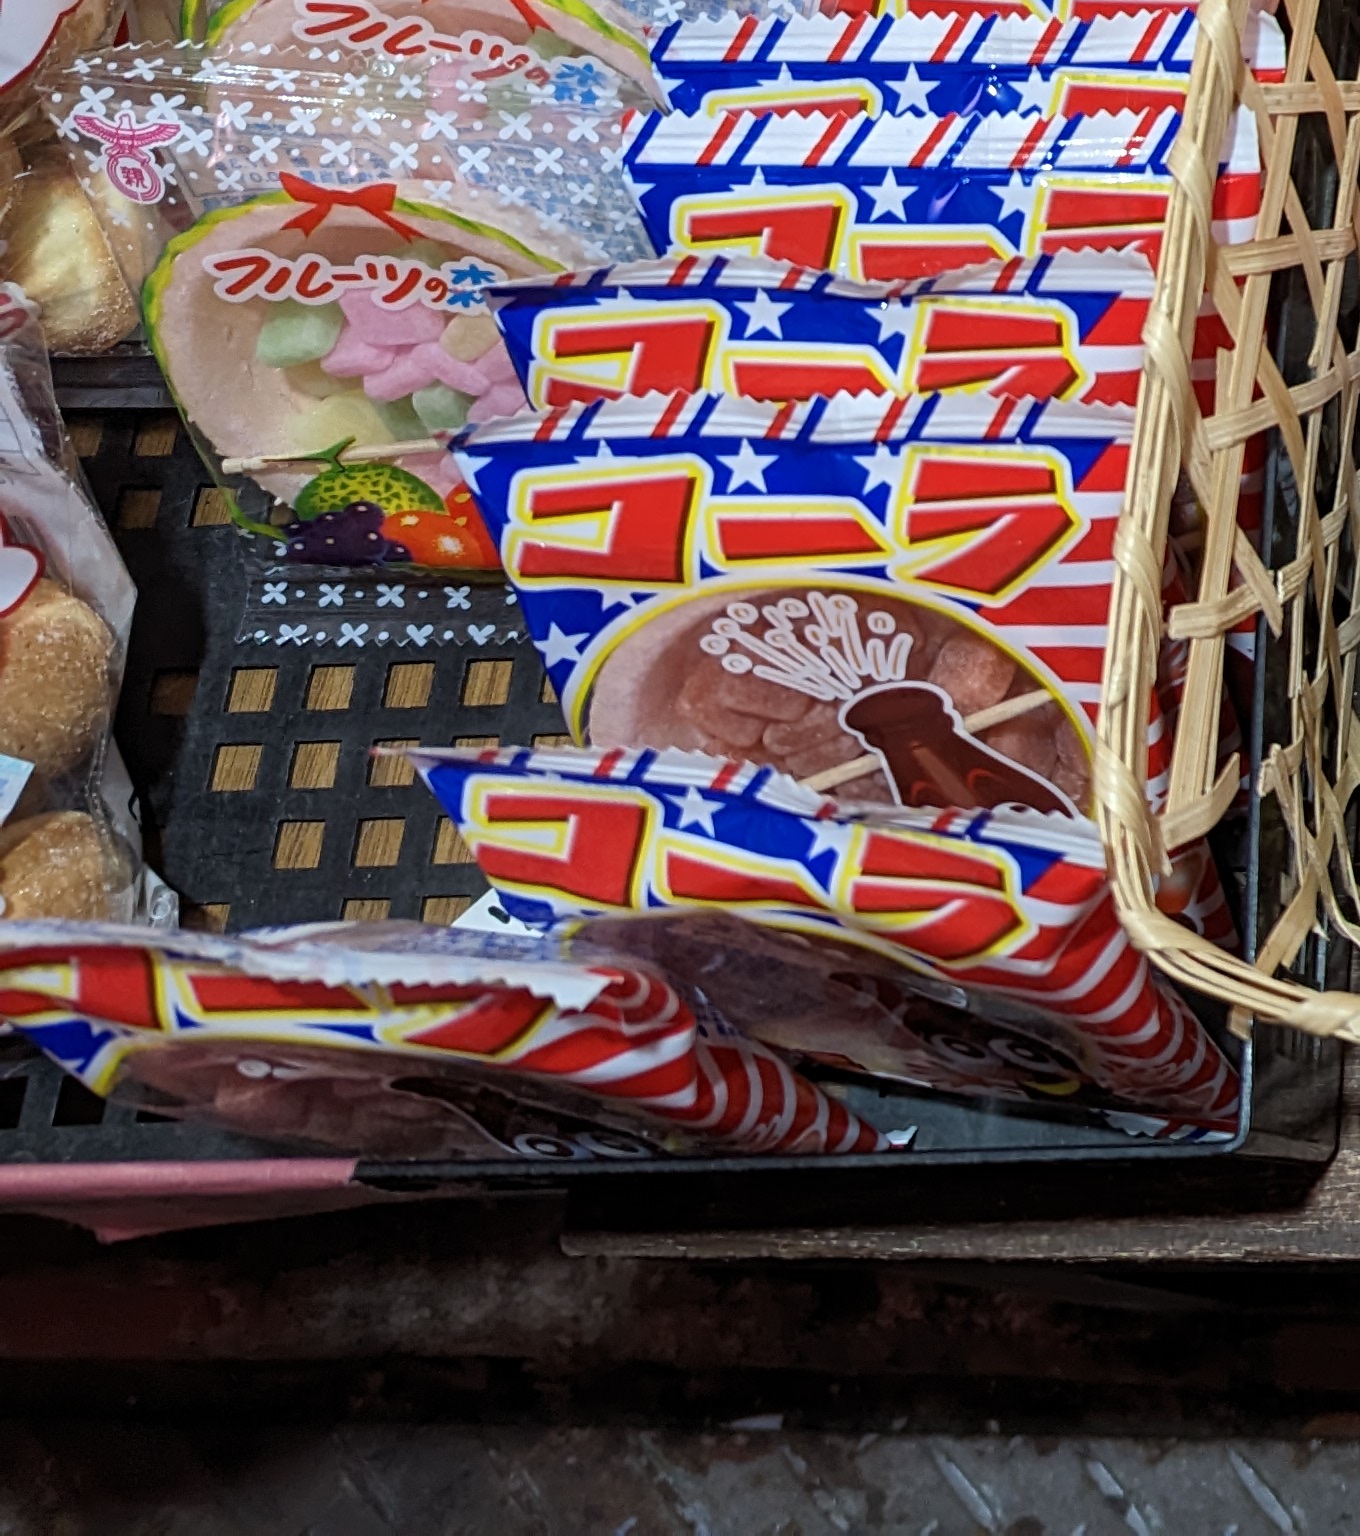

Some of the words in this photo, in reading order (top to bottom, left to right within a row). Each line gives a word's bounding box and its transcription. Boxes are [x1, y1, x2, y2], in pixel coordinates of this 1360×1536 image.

[213, 256, 499, 310] フルーツの森
[501, 440, 1091, 608] コーラ
[464, 775, 1033, 964] コーラ
